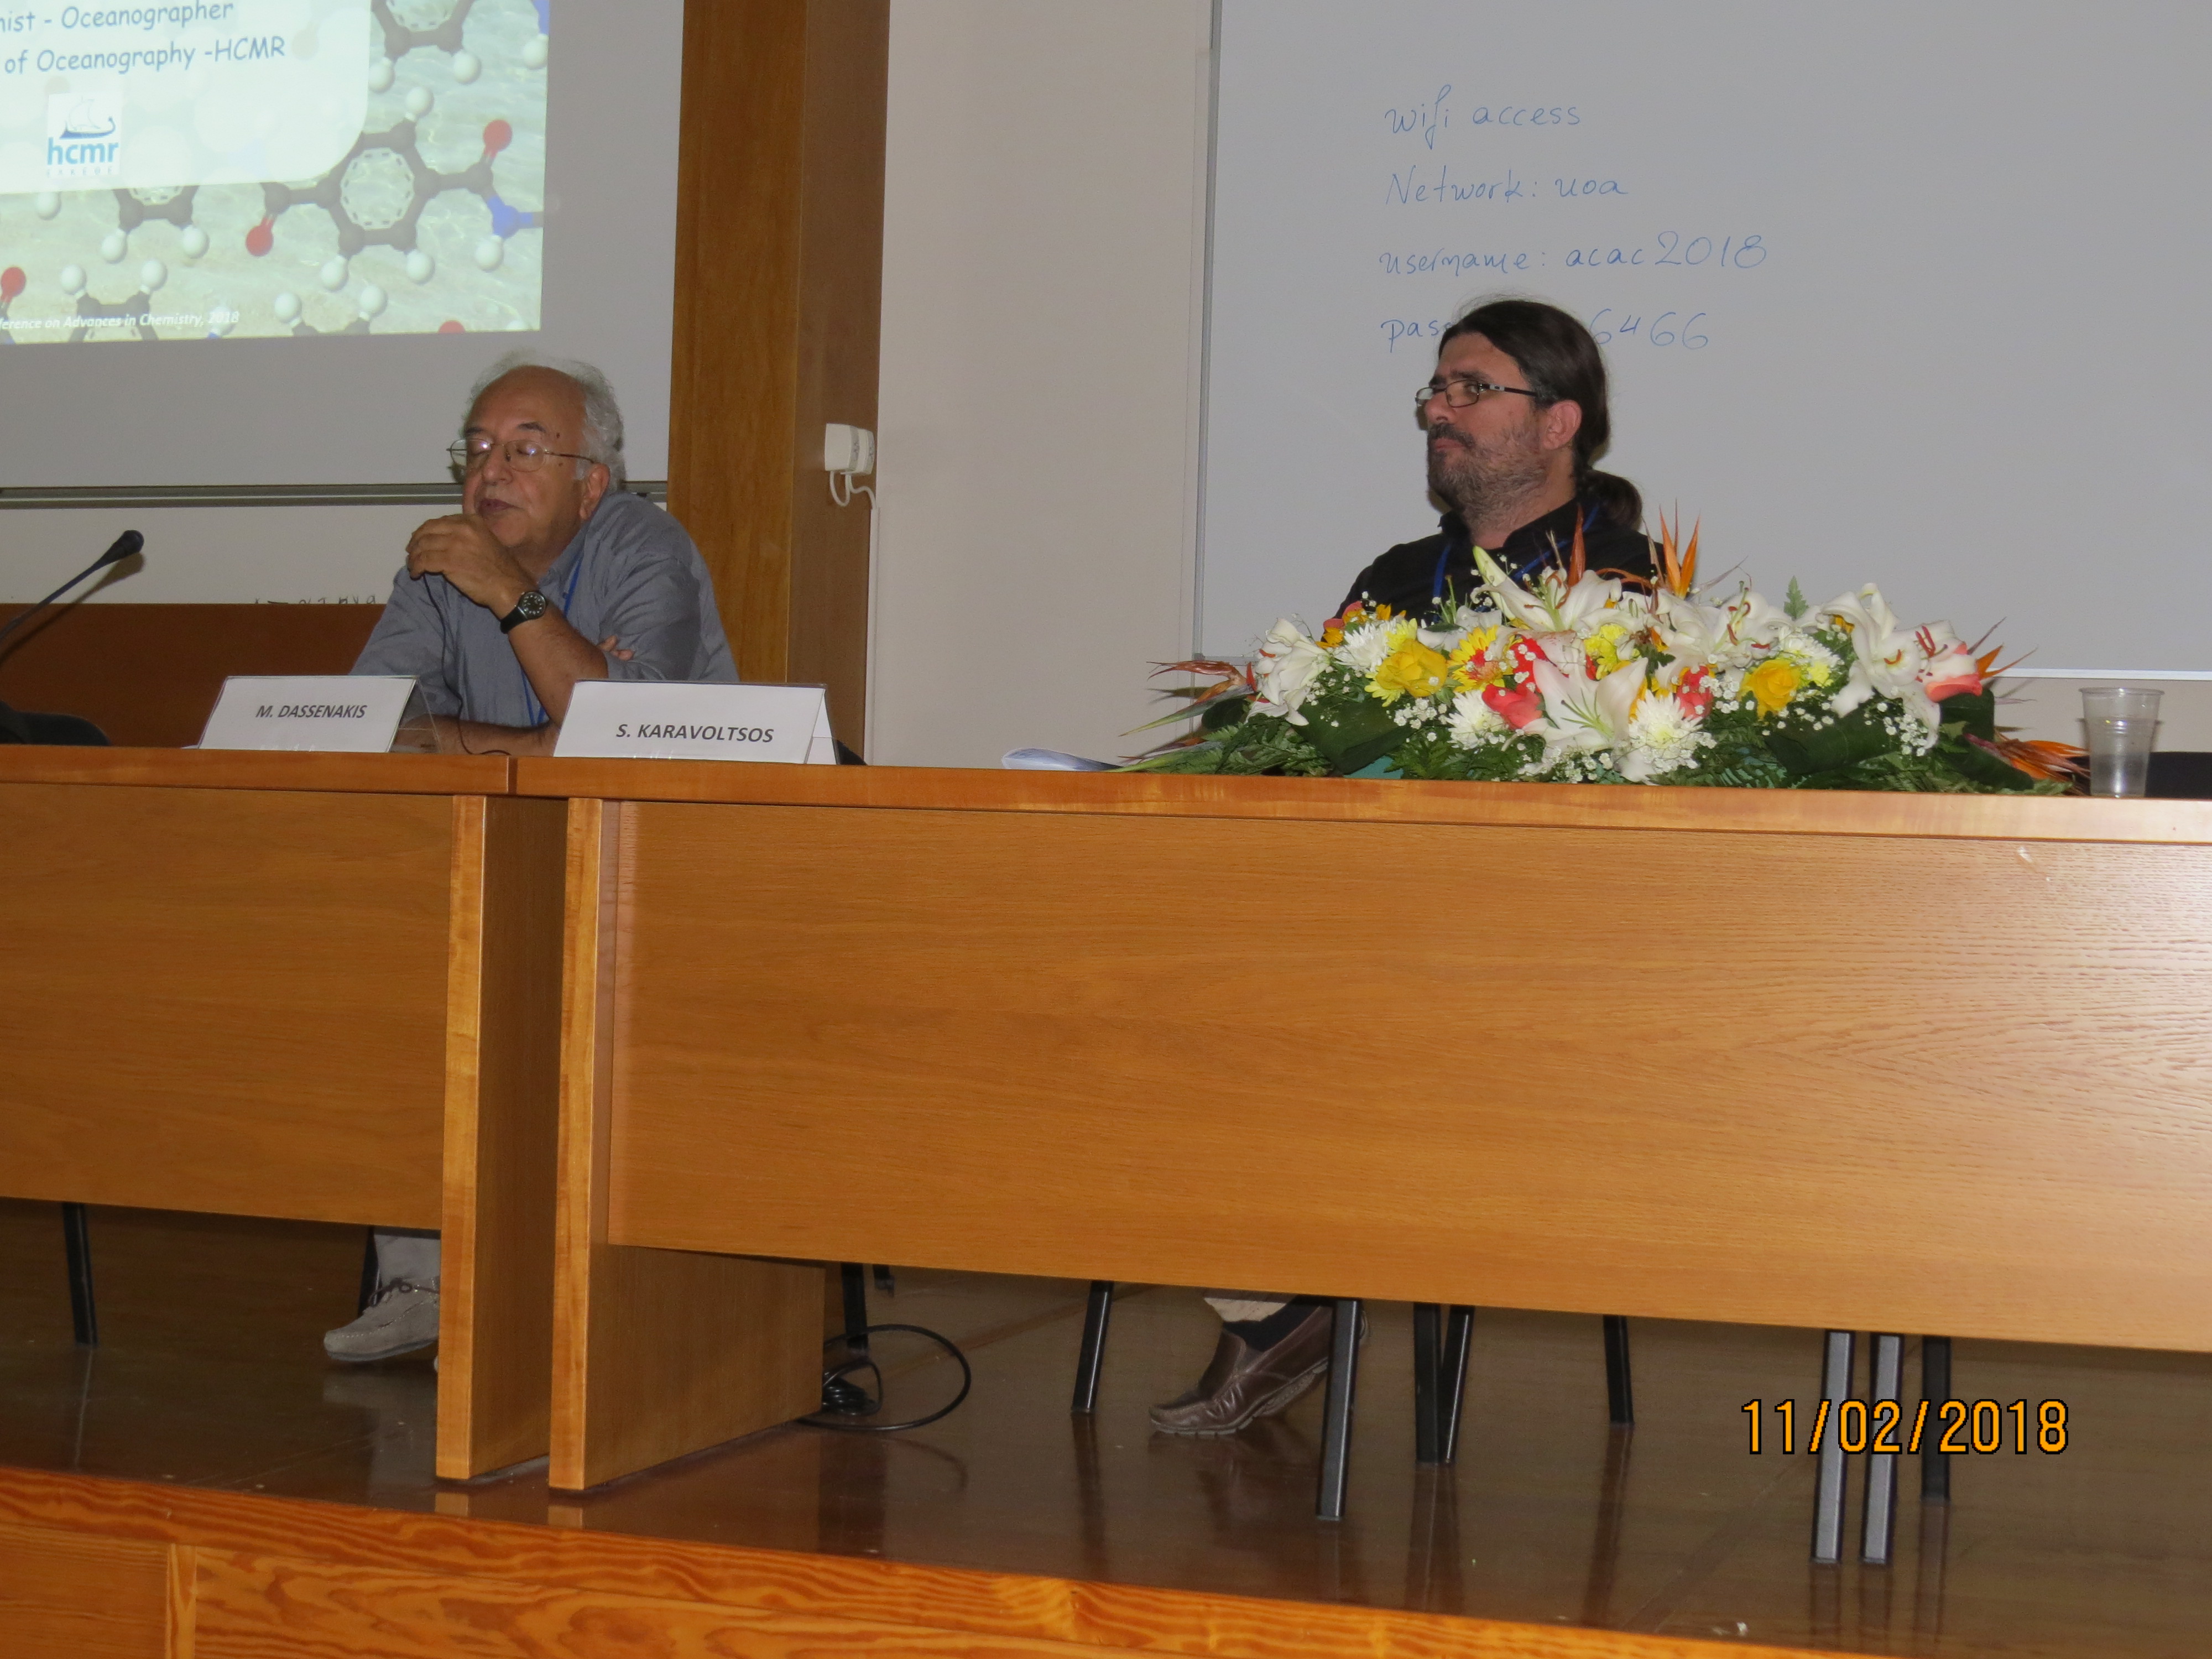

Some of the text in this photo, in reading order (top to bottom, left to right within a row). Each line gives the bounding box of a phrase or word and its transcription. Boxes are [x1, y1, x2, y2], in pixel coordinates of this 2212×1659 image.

[61, 0, 234, 30] Oceanographer
[4, 50, 28, 74] of
[36, 41, 196, 75] Oceanography
[1385, 84, 1581, 150] wifi access
[47, 137, 119, 165] hcmr
[1386, 165, 1629, 205] Network: uoa
[1379, 248, 1547, 277] username:
[45, 320, 61, 328] on
[63, 315, 122, 328] Advances
[125, 313, 137, 326] in
[139, 313, 204, 328] Chemistry,
[255, 705, 368, 719] M. DASSENAKIS
[616, 724, 774, 743] S. KARAVOLTSOS
